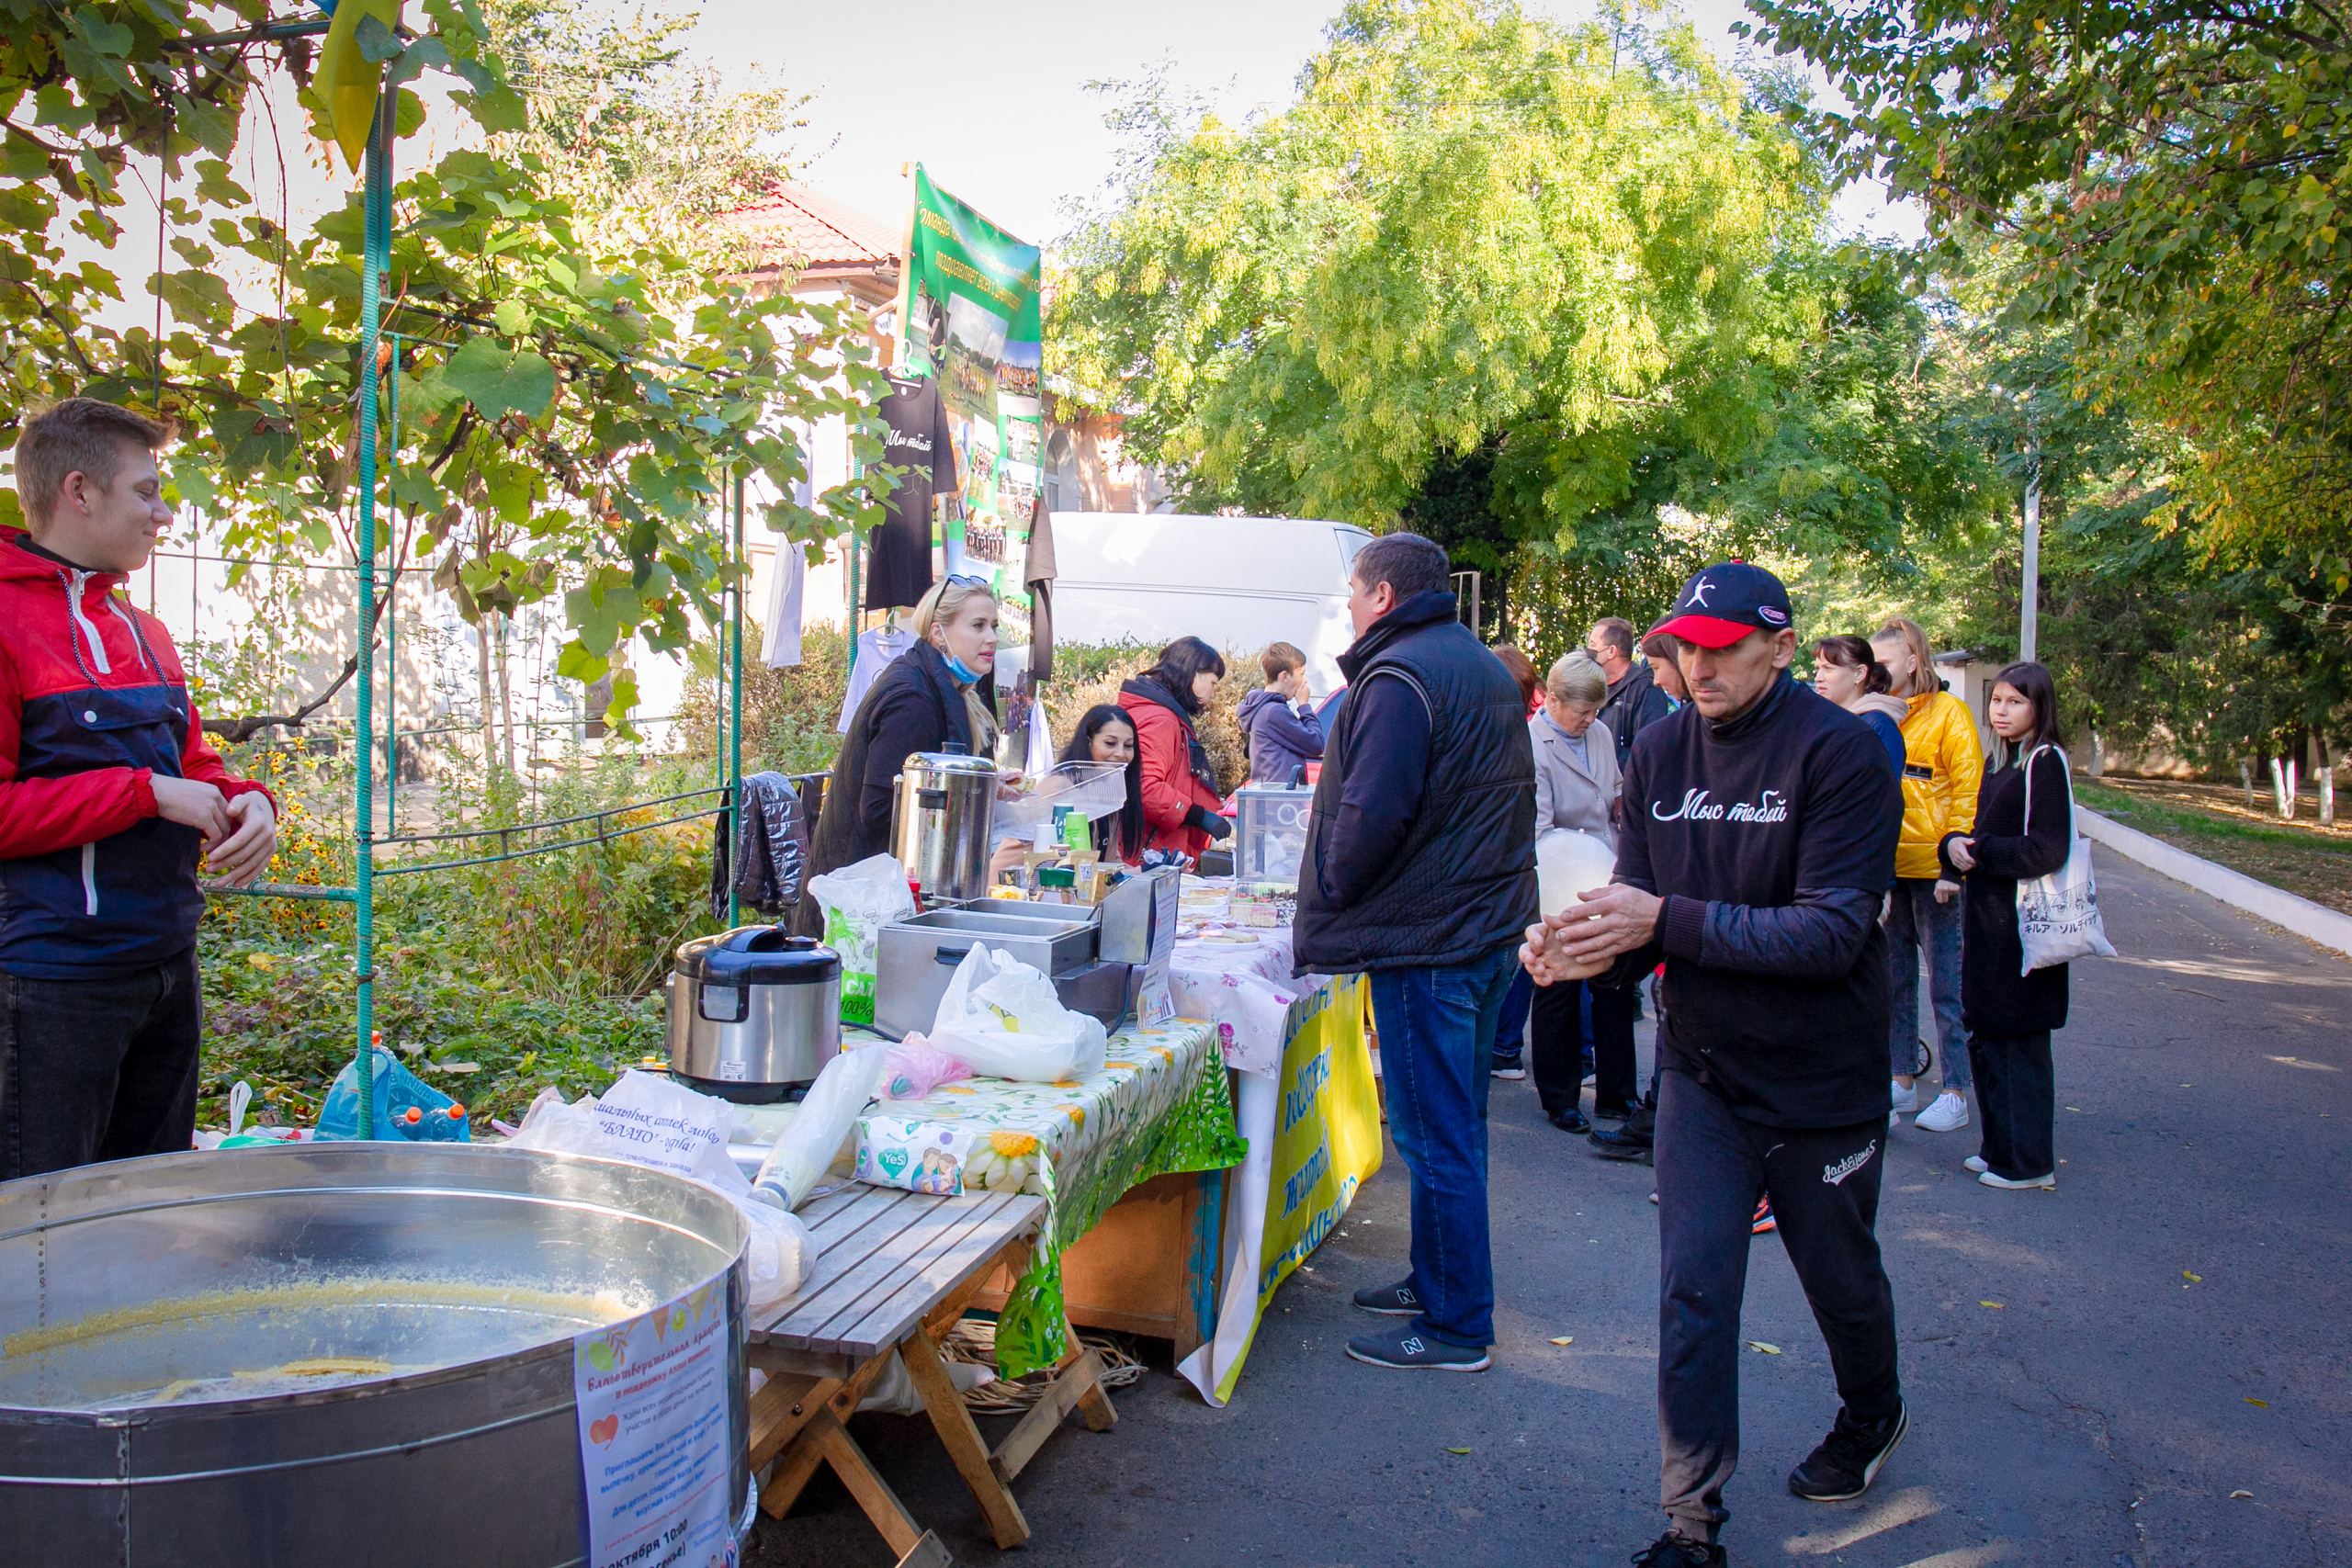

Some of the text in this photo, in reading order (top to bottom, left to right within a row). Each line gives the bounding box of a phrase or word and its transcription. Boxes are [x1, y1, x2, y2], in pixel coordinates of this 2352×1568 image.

[919, 200, 951, 239] оманда
[841, 999, 873, 1017] 100%
[587, 1340, 689, 1392] Благотворительная
[662, 1518, 688, 1545] 10:00
